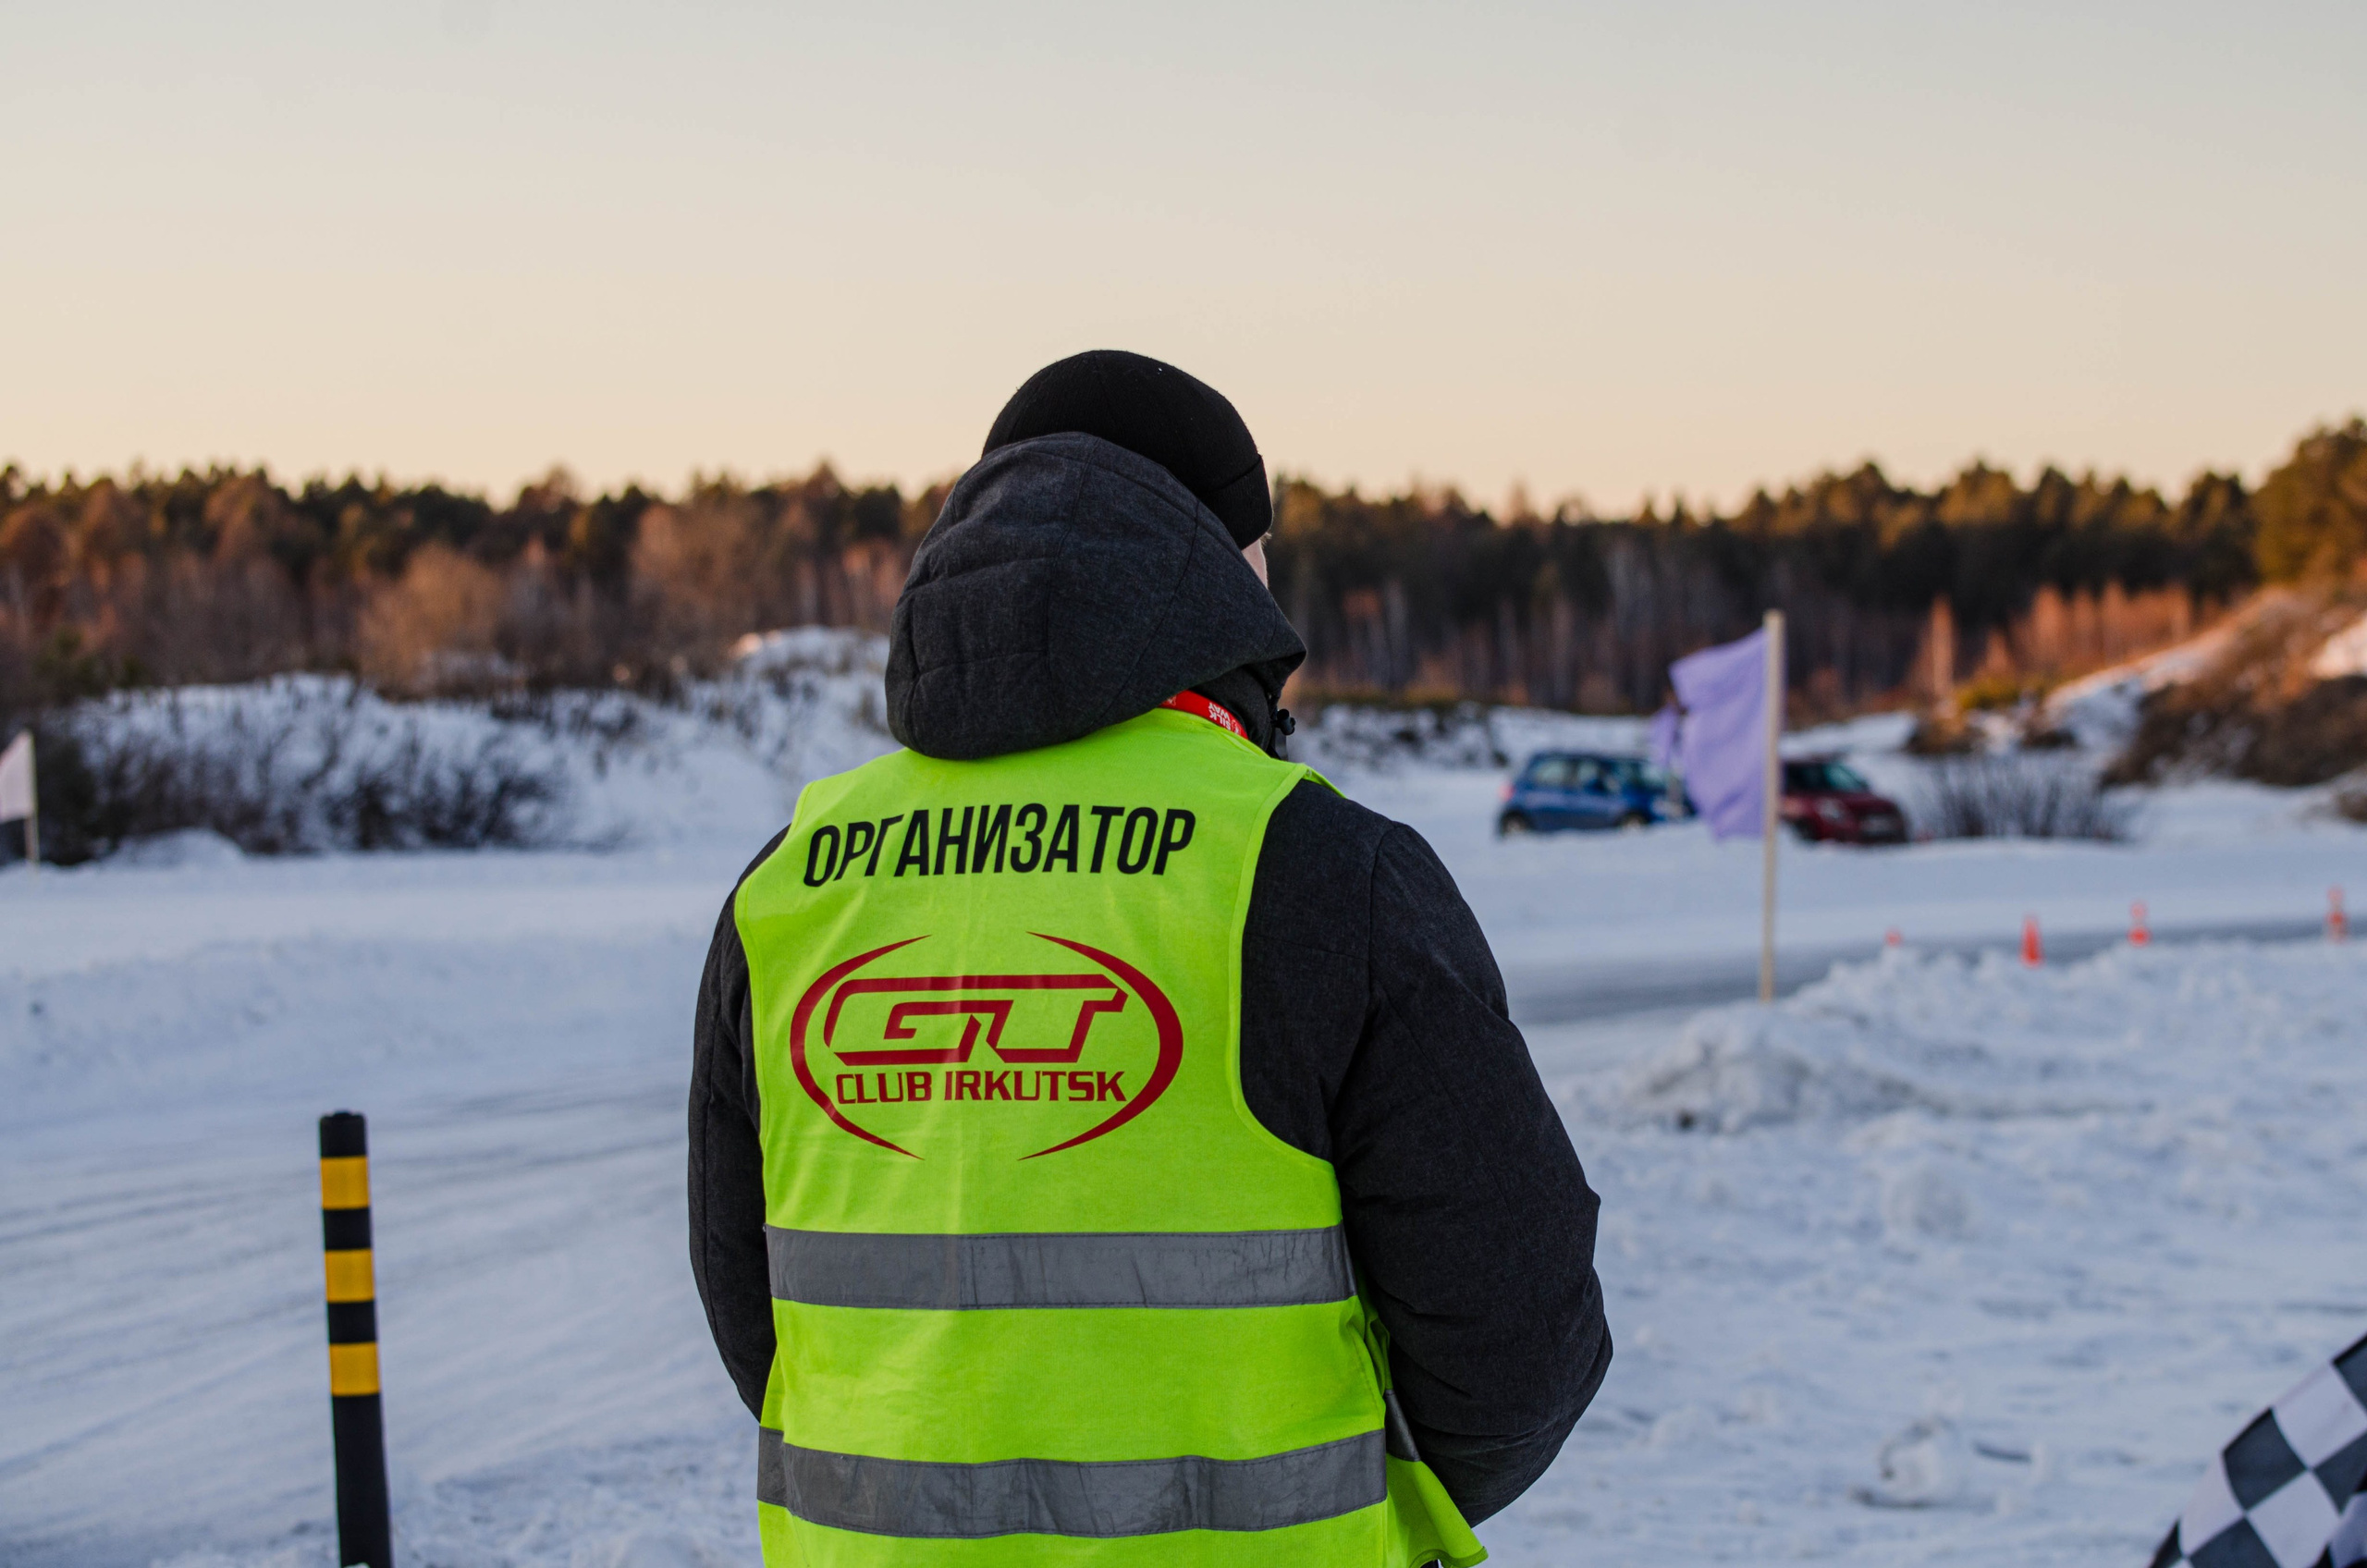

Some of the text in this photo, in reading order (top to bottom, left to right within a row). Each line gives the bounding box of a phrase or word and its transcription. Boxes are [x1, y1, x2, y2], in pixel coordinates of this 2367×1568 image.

[1208, 703, 1230, 722] WAY
[1209, 709, 1231, 730] SILK
[803, 802, 1196, 887] ОРГАНИЗАТОР
[836, 1071, 1126, 1104] CLUB IRKUTSK
